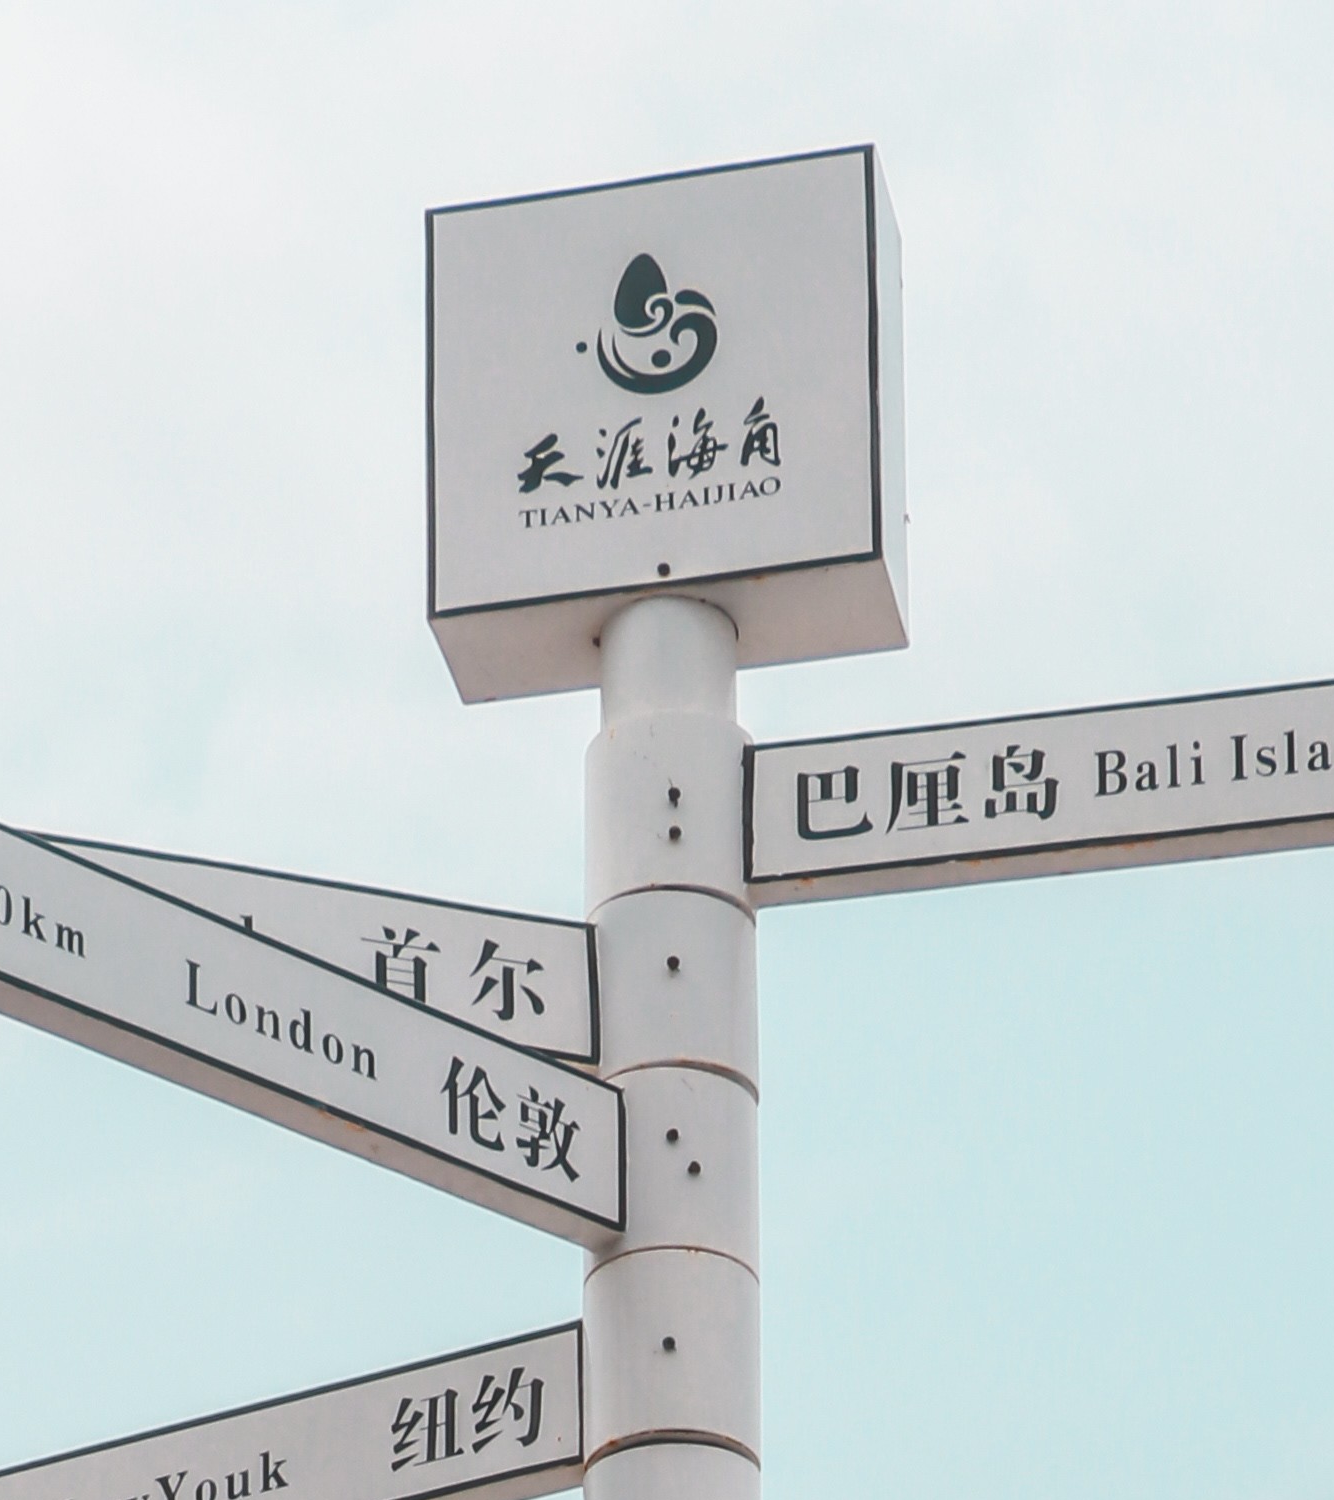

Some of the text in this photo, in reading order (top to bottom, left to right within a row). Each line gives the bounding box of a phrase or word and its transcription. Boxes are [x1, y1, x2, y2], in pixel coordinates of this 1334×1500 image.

[517, 396, 781, 493] 天涯海角
[519, 477, 781, 528] TIANYA-HAIJIAO
[797, 745, 1059, 840] 巴厘岛
[1095, 741, 1205, 797] Bali
[362, 926, 544, 1021] 首尔
[186, 960, 376, 1080] London
[441, 1056, 580, 1182] 伦敦
[391, 1367, 544, 1472] 纽约
